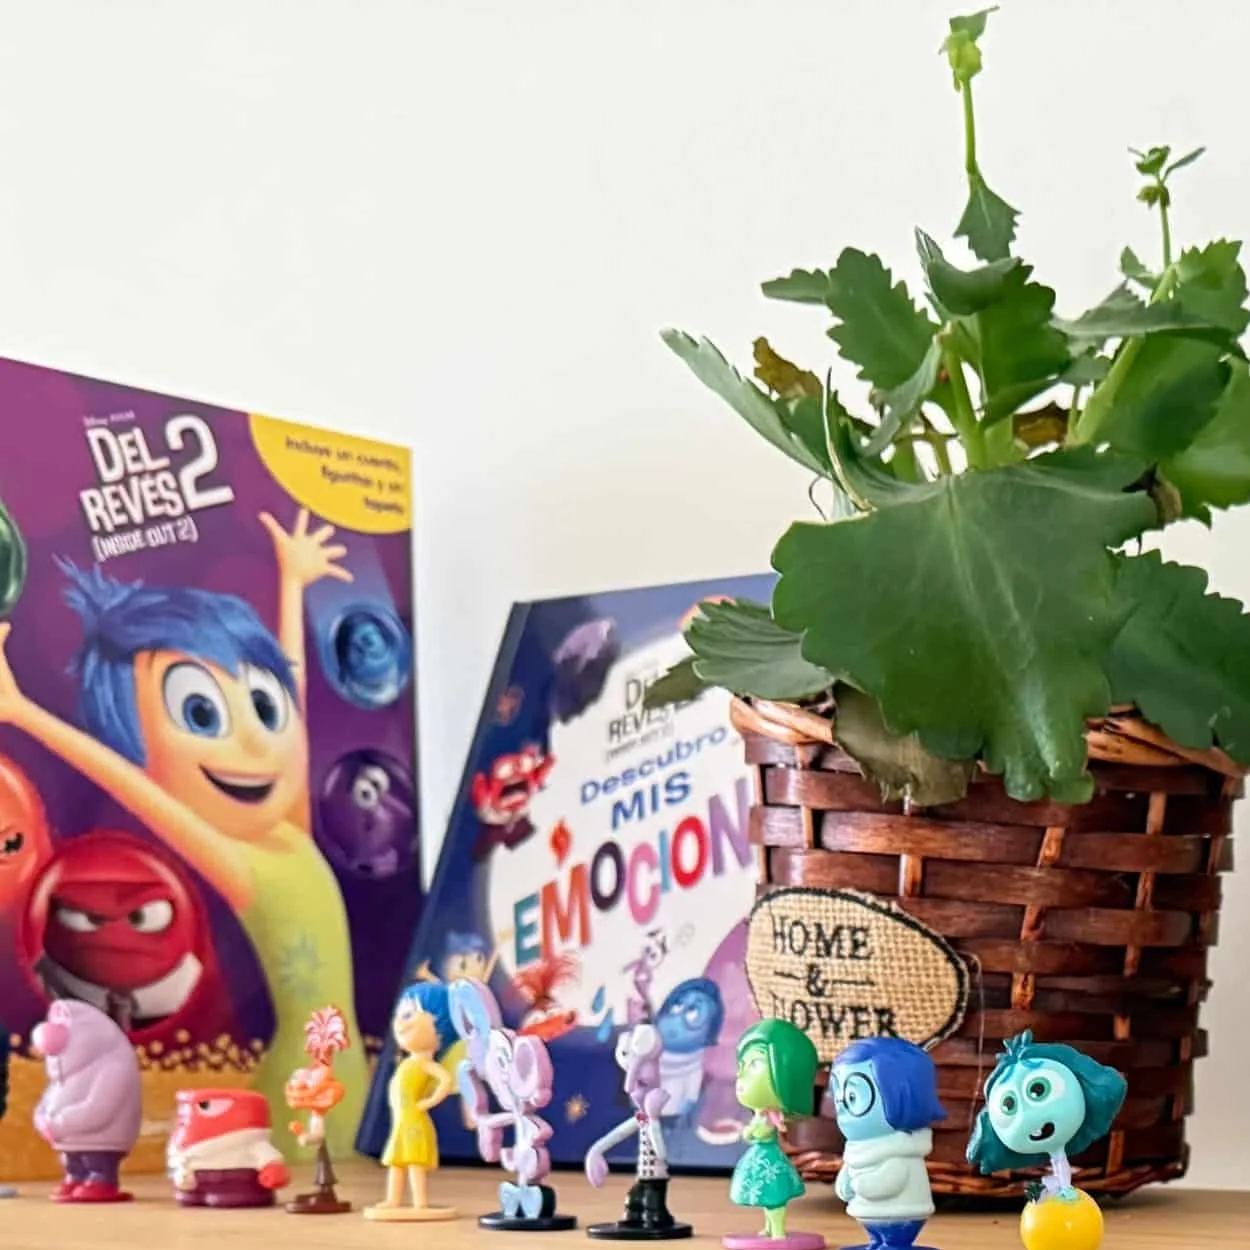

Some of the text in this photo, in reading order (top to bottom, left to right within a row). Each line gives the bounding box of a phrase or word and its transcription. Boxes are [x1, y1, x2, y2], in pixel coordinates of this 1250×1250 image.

[87, 427, 171, 483] DEL
[165, 414, 235, 511] 2
[146, 522, 178, 548] OUT
[177, 514, 199, 543] 2)
[580, 726, 727, 805] Descubro
[611, 771, 691, 831] MIS
[772, 915, 874, 960] HOME
[806, 963, 832, 998] &
